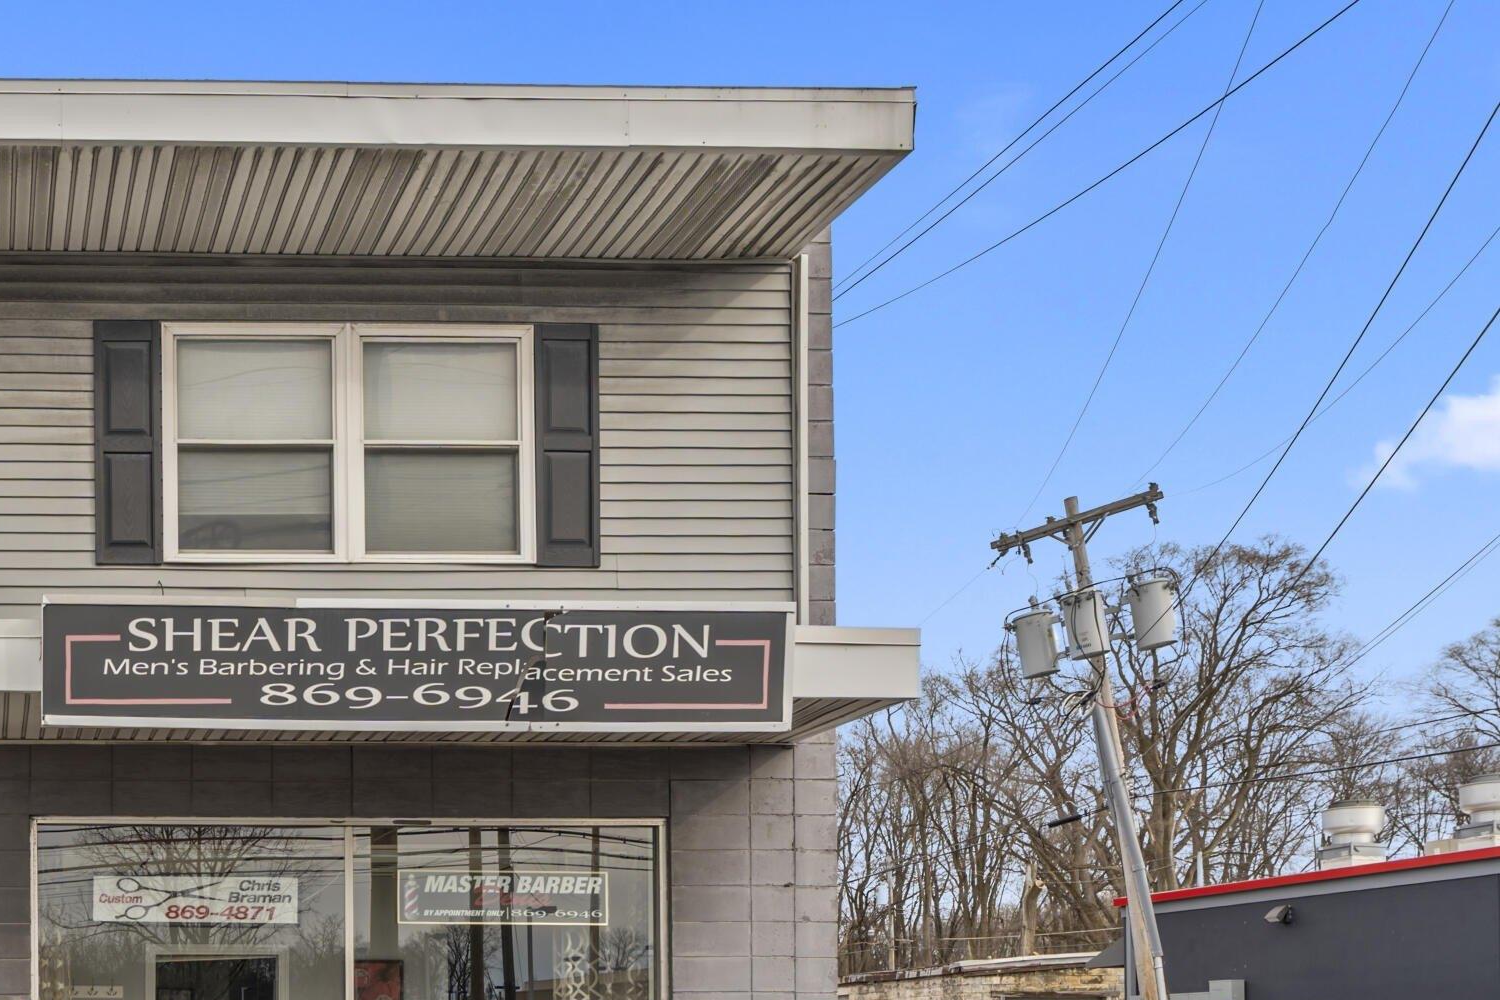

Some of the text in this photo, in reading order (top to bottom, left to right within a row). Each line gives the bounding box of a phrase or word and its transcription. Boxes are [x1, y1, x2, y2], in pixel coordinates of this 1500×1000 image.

[127, 617, 711, 659] SHEAR PERFECTION
[102, 657, 733, 683] Men's Barbering & Hair Replacement Sales
[259, 682, 580, 715] 869-6946
[239, 879, 281, 892] Chris
[423, 875, 603, 895] MASTER BARBER
[98, 893, 143, 905] Custom
[227, 892, 292, 905] Braman
[164, 904, 277, 921] 869-4871
[423, 908, 505, 918] BY APPOINTMENT ONLY
